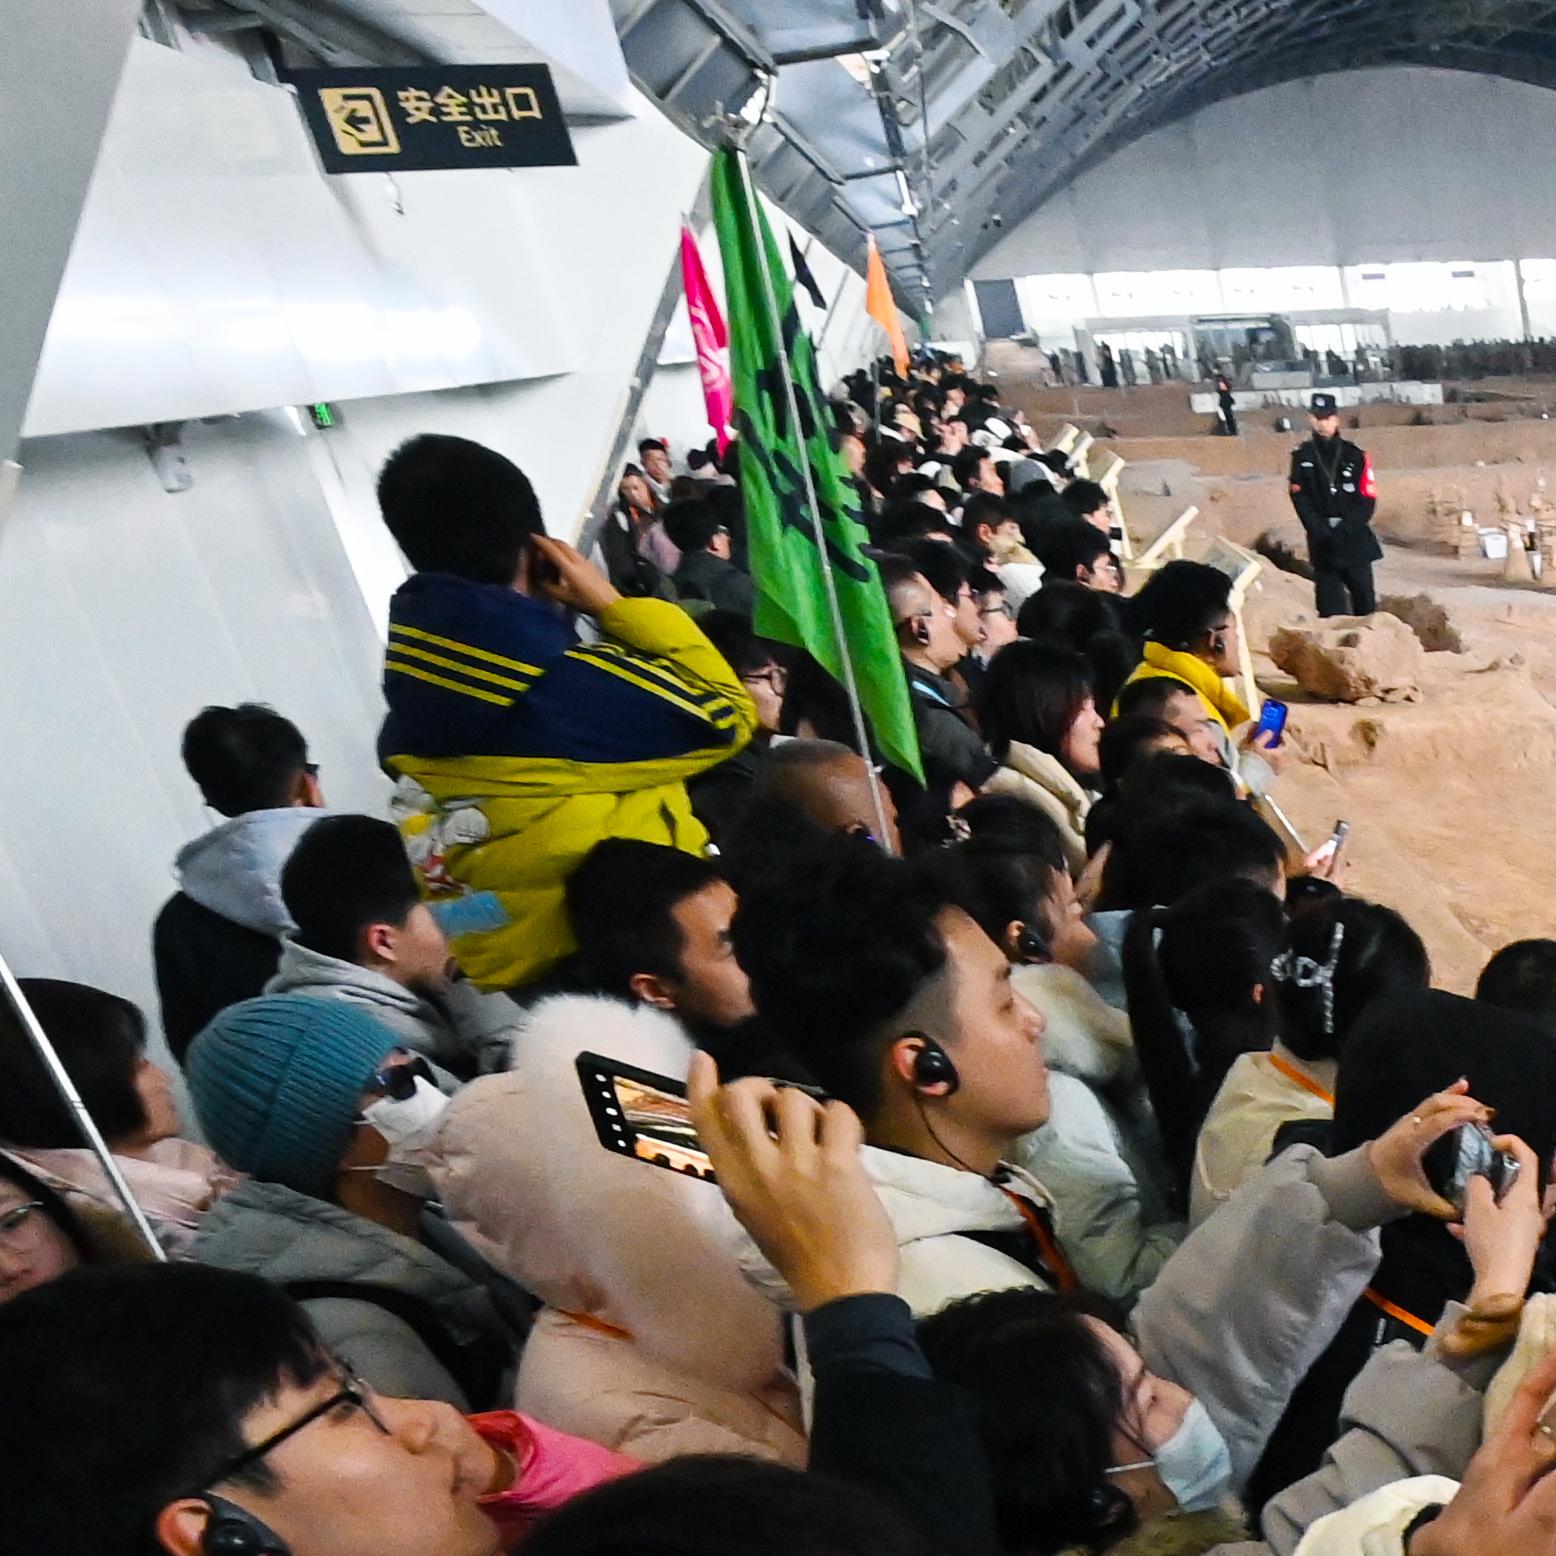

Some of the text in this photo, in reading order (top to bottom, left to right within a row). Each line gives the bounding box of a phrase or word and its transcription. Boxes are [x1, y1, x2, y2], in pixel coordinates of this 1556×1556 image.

[397, 84, 543, 125] 安全出口
[456, 124, 504, 147] Exit
